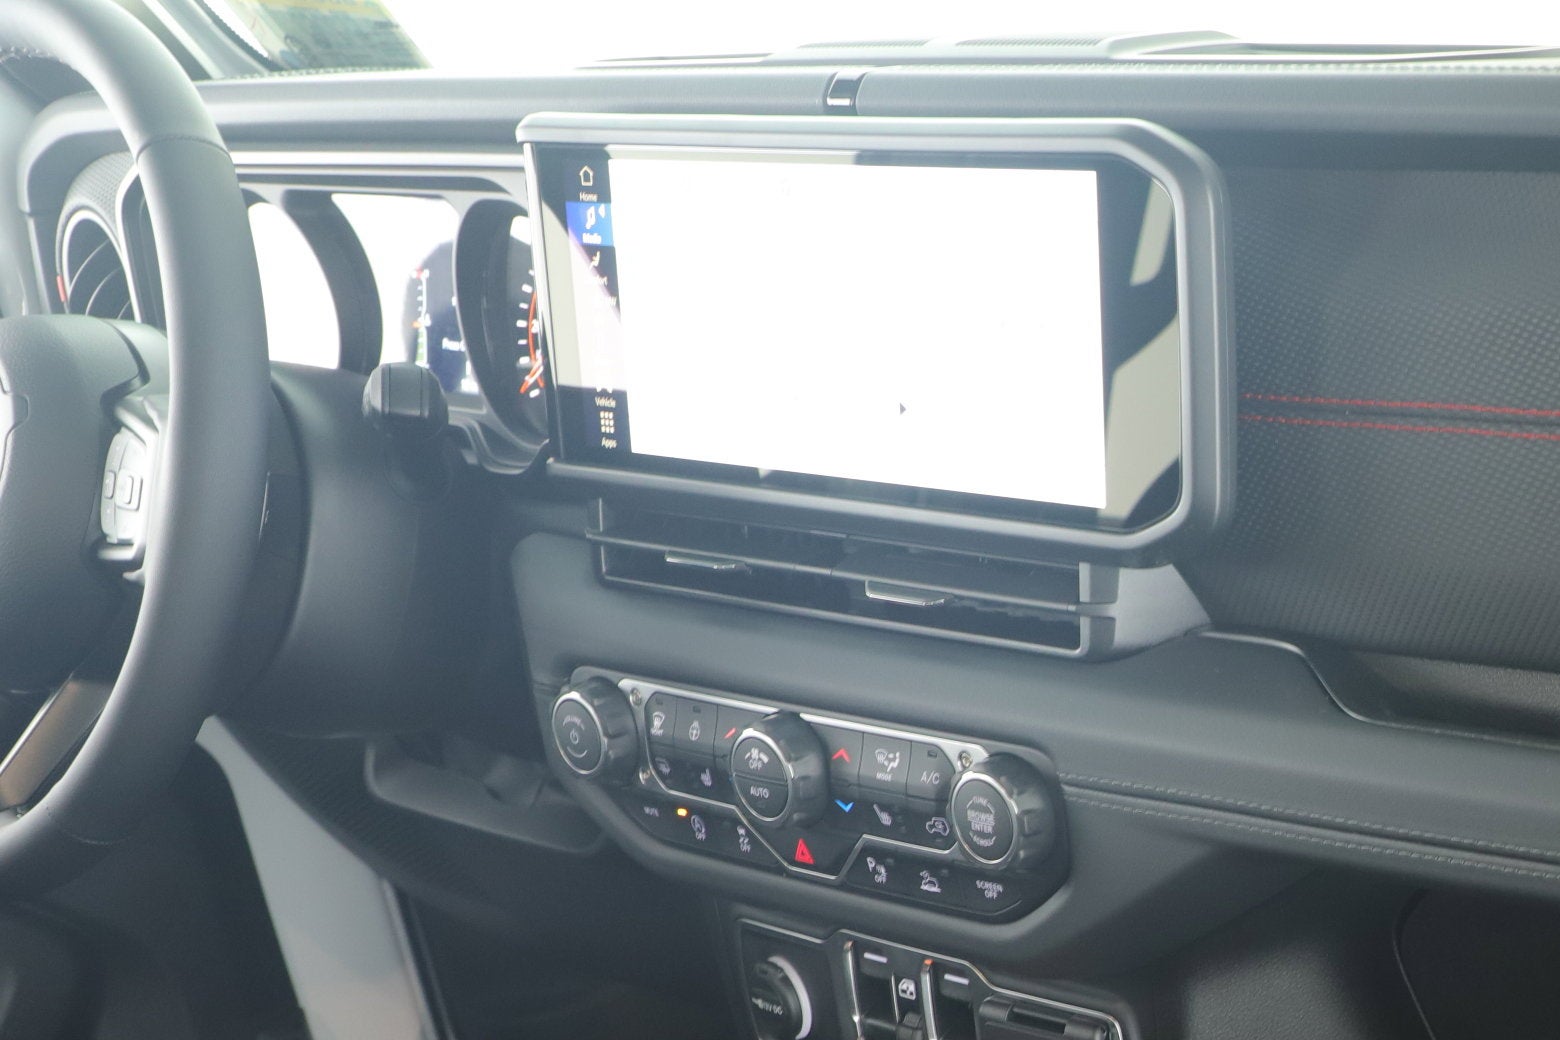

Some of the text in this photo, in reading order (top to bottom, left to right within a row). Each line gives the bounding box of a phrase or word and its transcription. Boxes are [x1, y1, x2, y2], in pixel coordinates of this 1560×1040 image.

[579, 191, 598, 202] Home
[595, 396, 617, 409] Vehicle
[601, 436, 618, 450] Apps
[748, 758, 764, 771] OFF
[876, 771, 894, 782] MODE
[920, 770, 941, 785] A/C
[750, 785, 770, 799] AUTO
[971, 821, 994, 835] ENTER
[975, 879, 1004, 894] SCREEN
